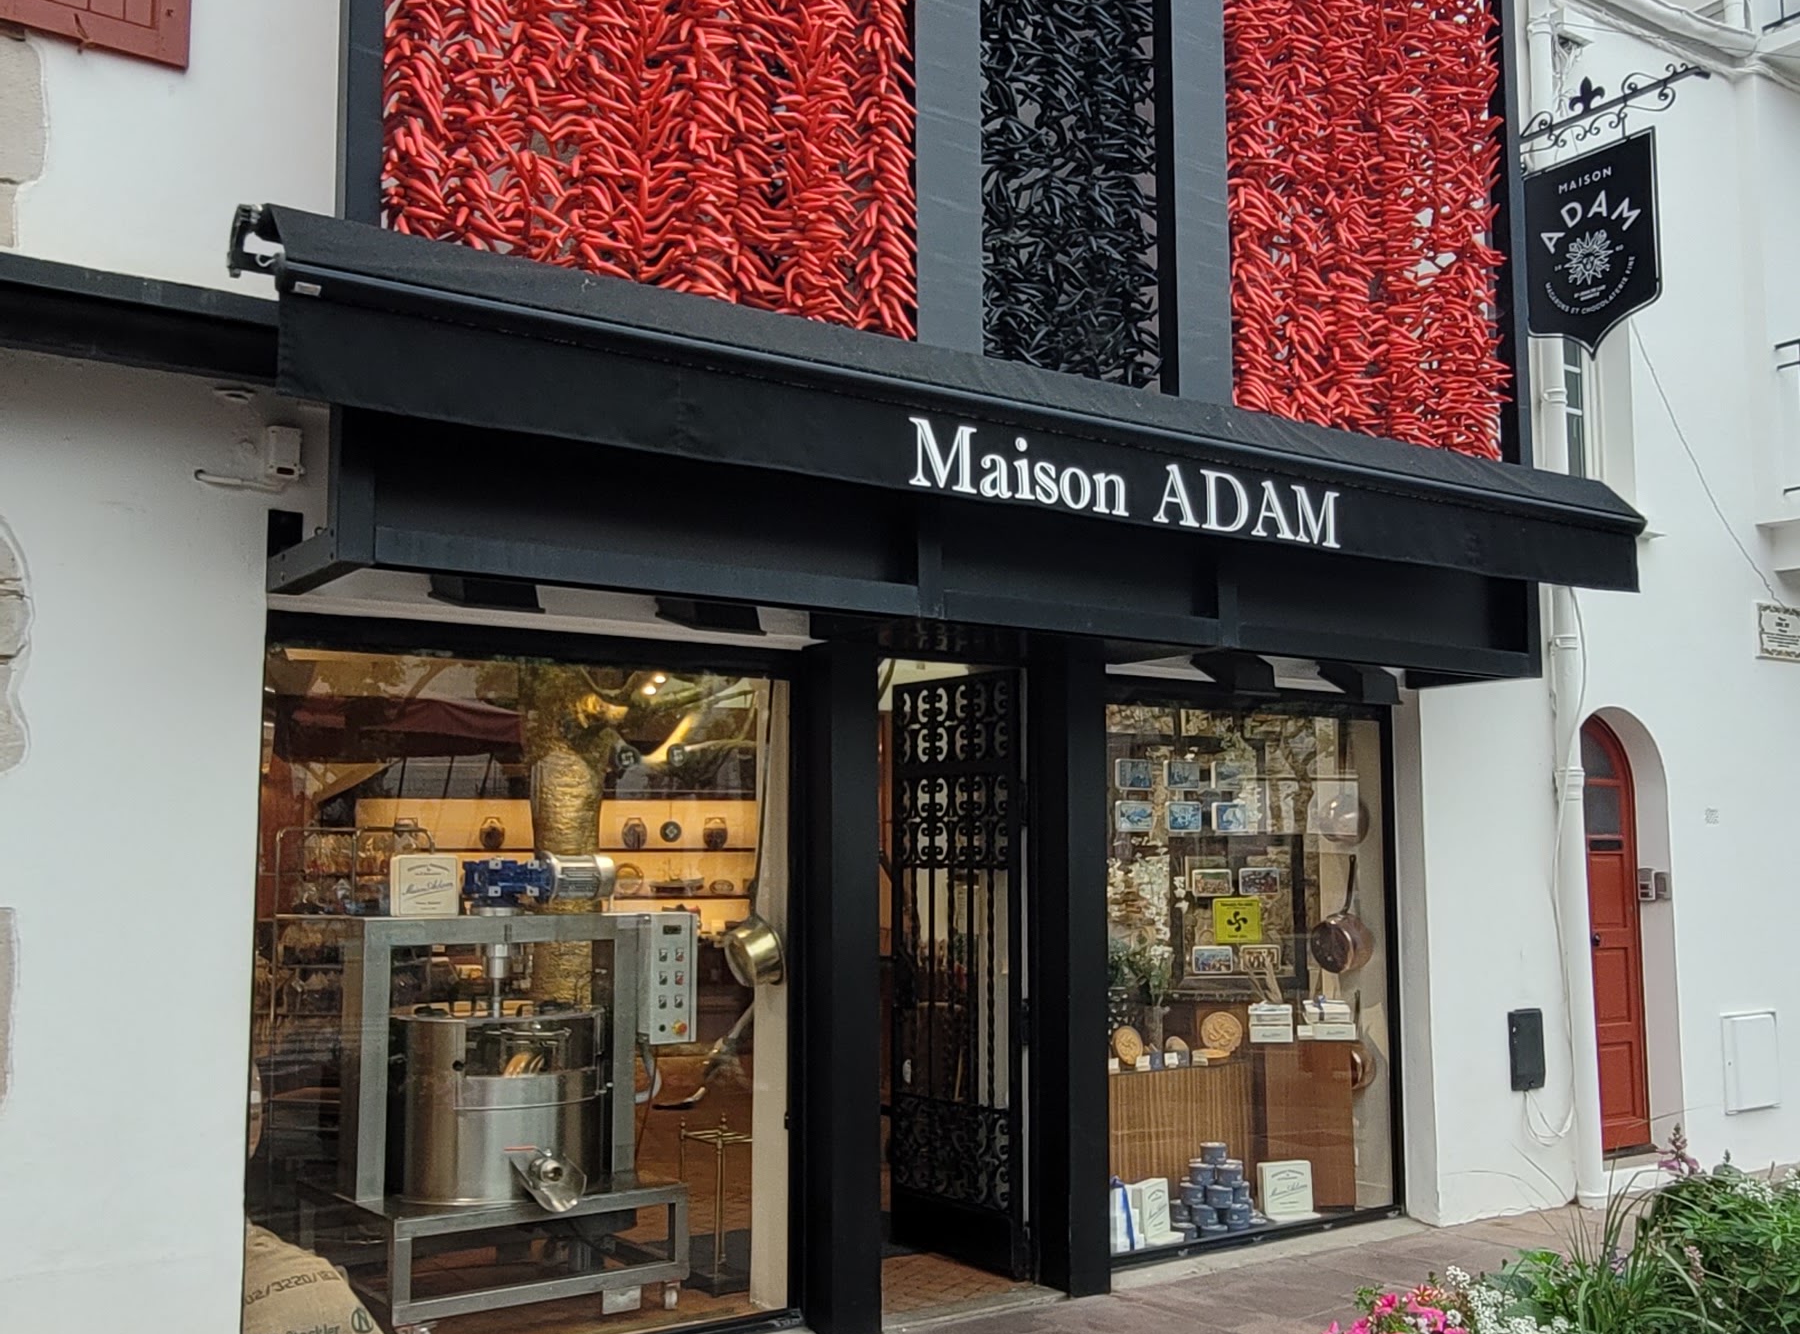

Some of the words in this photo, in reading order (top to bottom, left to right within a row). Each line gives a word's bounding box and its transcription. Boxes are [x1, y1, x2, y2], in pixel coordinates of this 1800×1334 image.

[1558, 166, 1612, 194] MAISON
[1540, 190, 1642, 255] ADAM
[1581, 276, 1629, 315] CHOCOLATERIE
[908, 417, 1129, 517] Maison
[1153, 464, 1341, 549] ADAM
